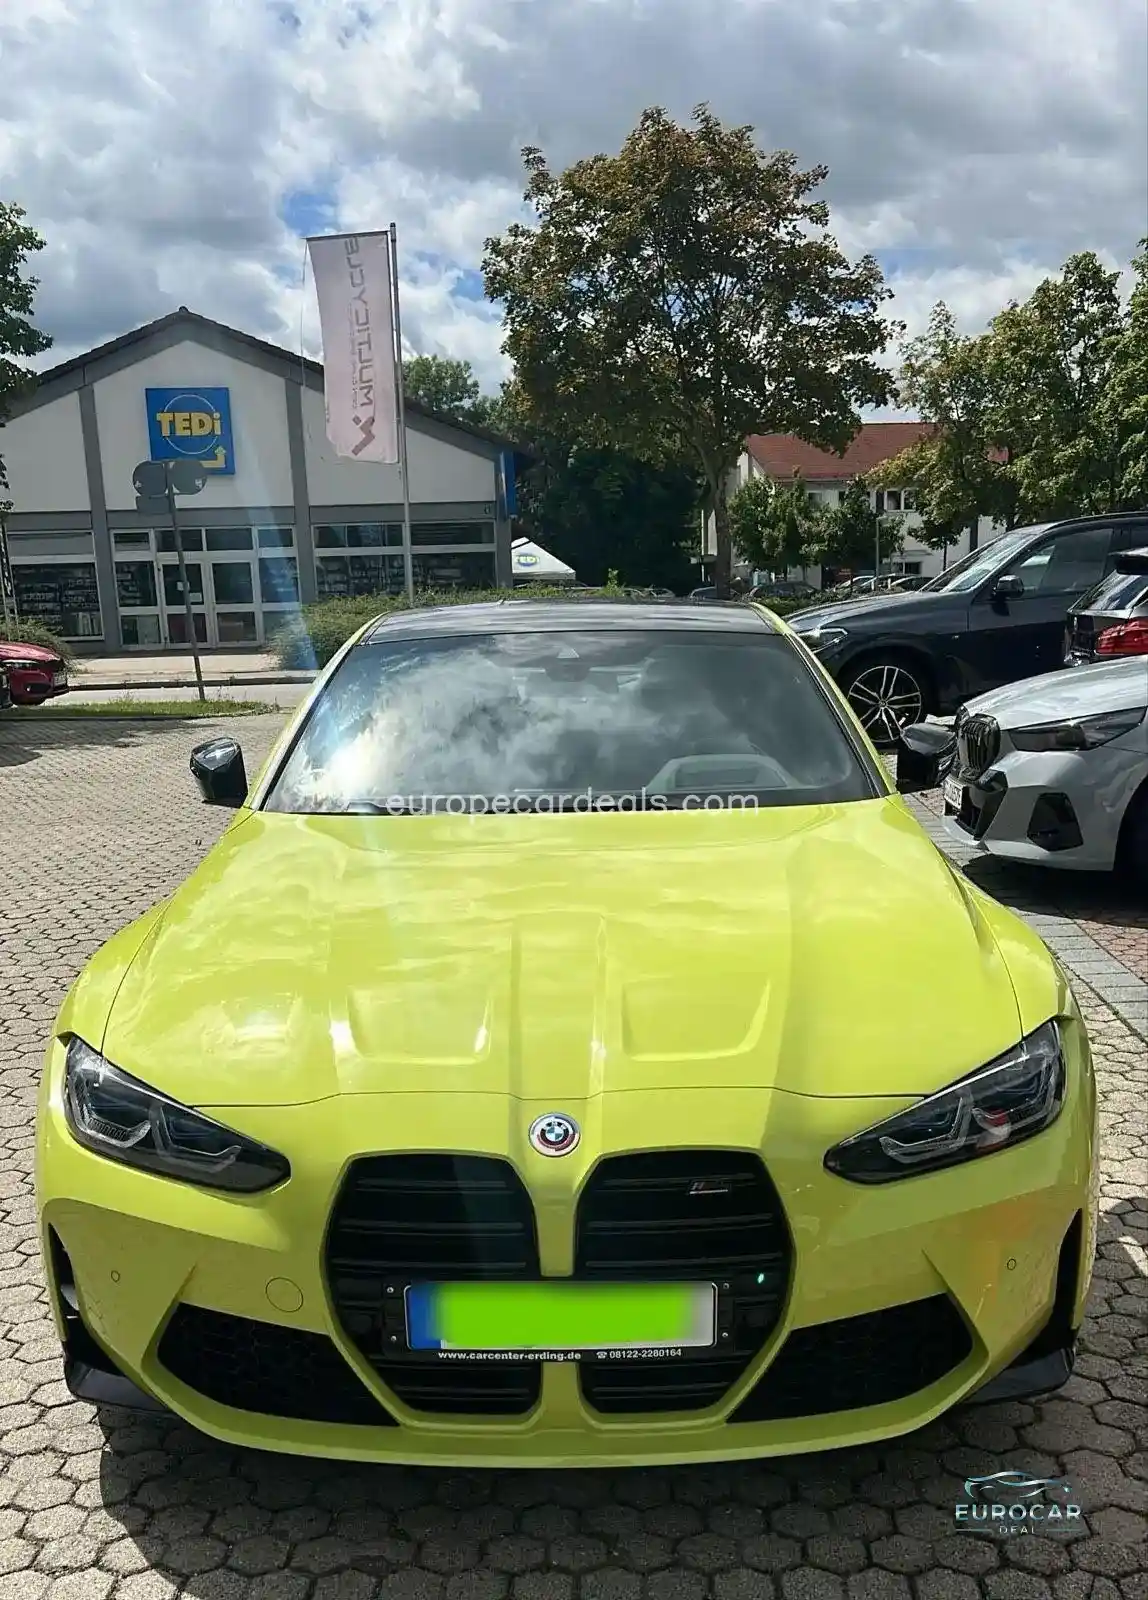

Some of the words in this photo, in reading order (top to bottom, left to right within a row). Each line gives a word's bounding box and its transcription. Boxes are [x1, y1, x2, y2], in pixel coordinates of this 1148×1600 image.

[156, 411, 221, 437] TEDi
[438, 1351, 582, 1362] www.carcenter-erding.de
[609, 1348, 682, 1359] 08122-2280164
